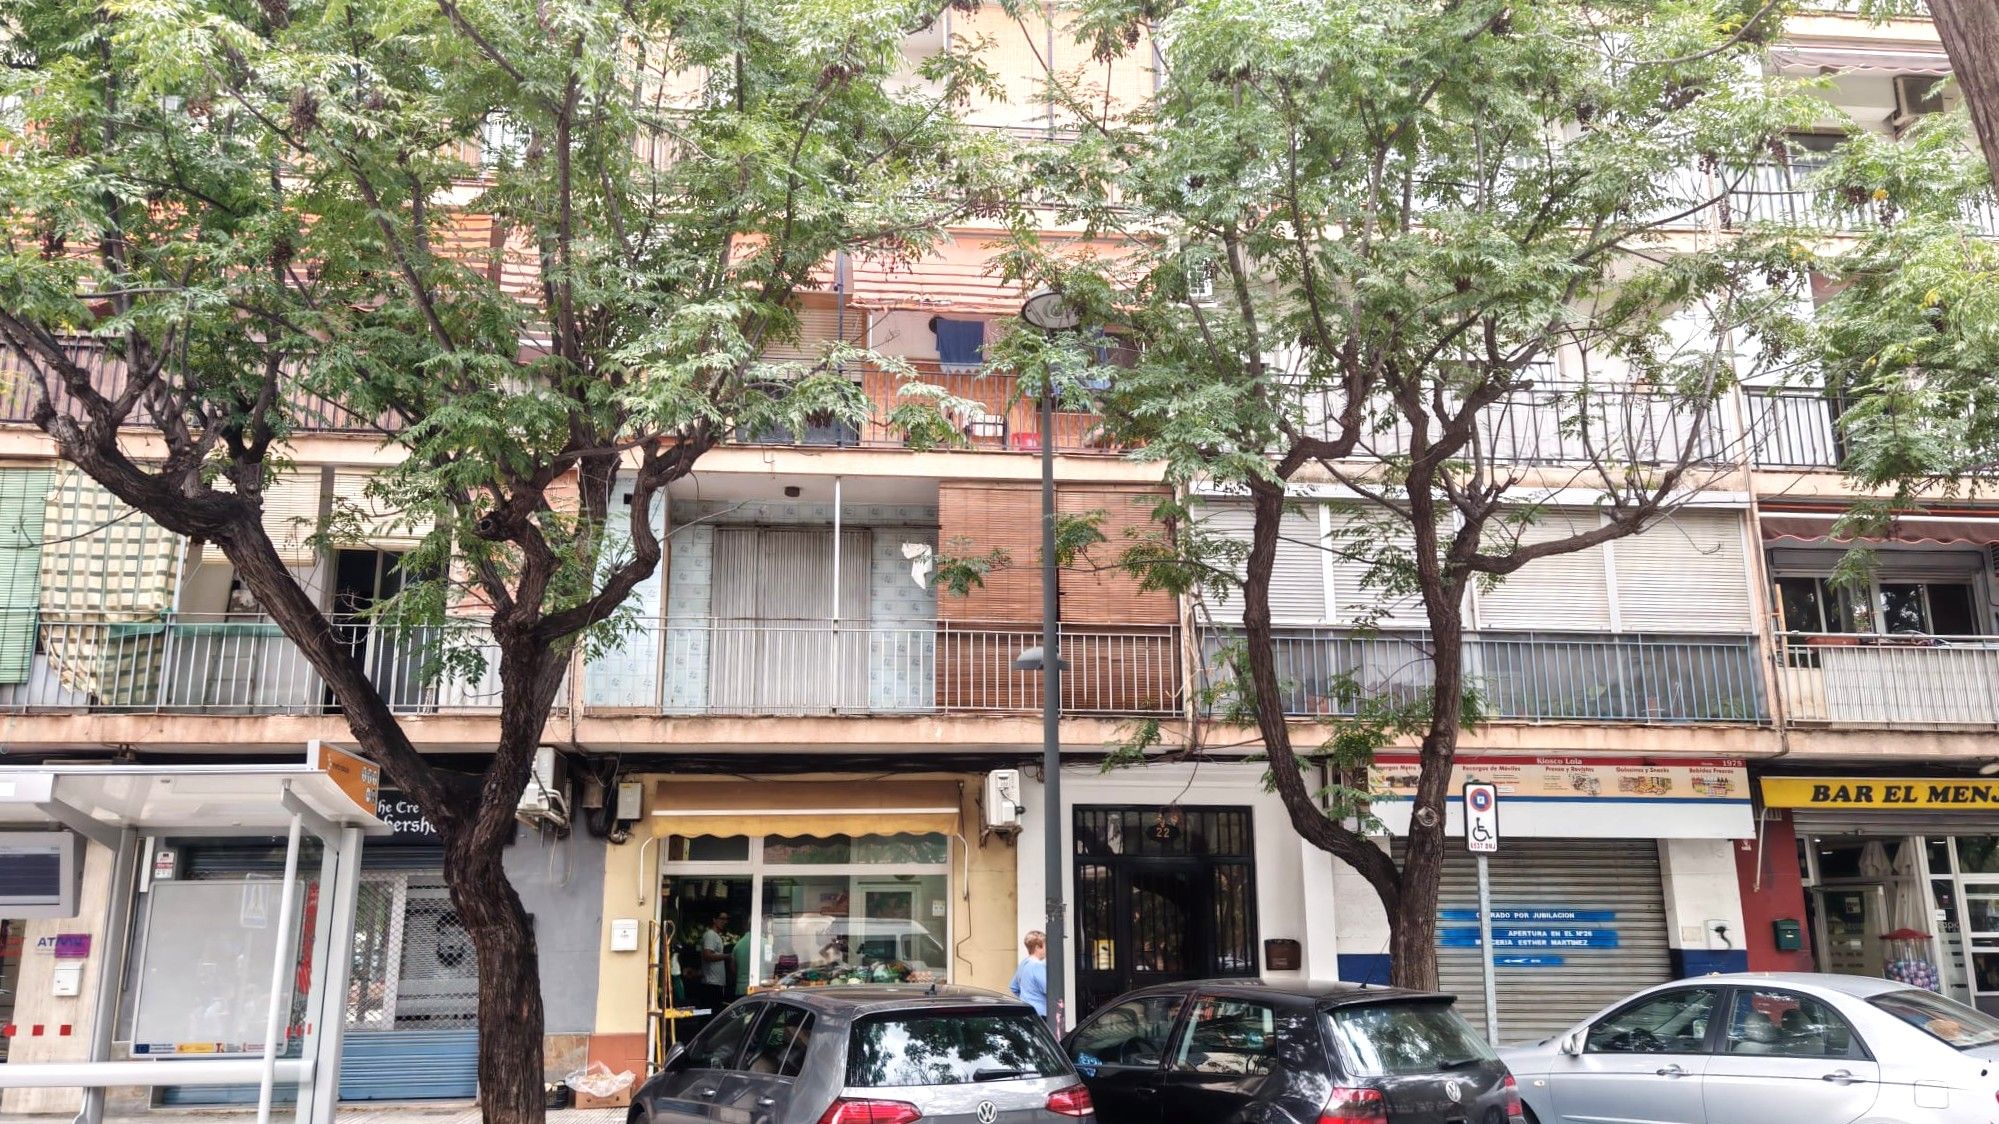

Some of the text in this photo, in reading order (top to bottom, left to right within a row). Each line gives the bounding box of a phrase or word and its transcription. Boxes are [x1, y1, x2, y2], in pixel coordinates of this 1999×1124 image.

[1811, 785, 1873, 803] BAR
[1882, 786, 1917, 803] EL
[378, 799, 419, 814] he Cre
[1156, 828, 1170, 838] 22
[1475, 938, 1513, 946] MCERIA
